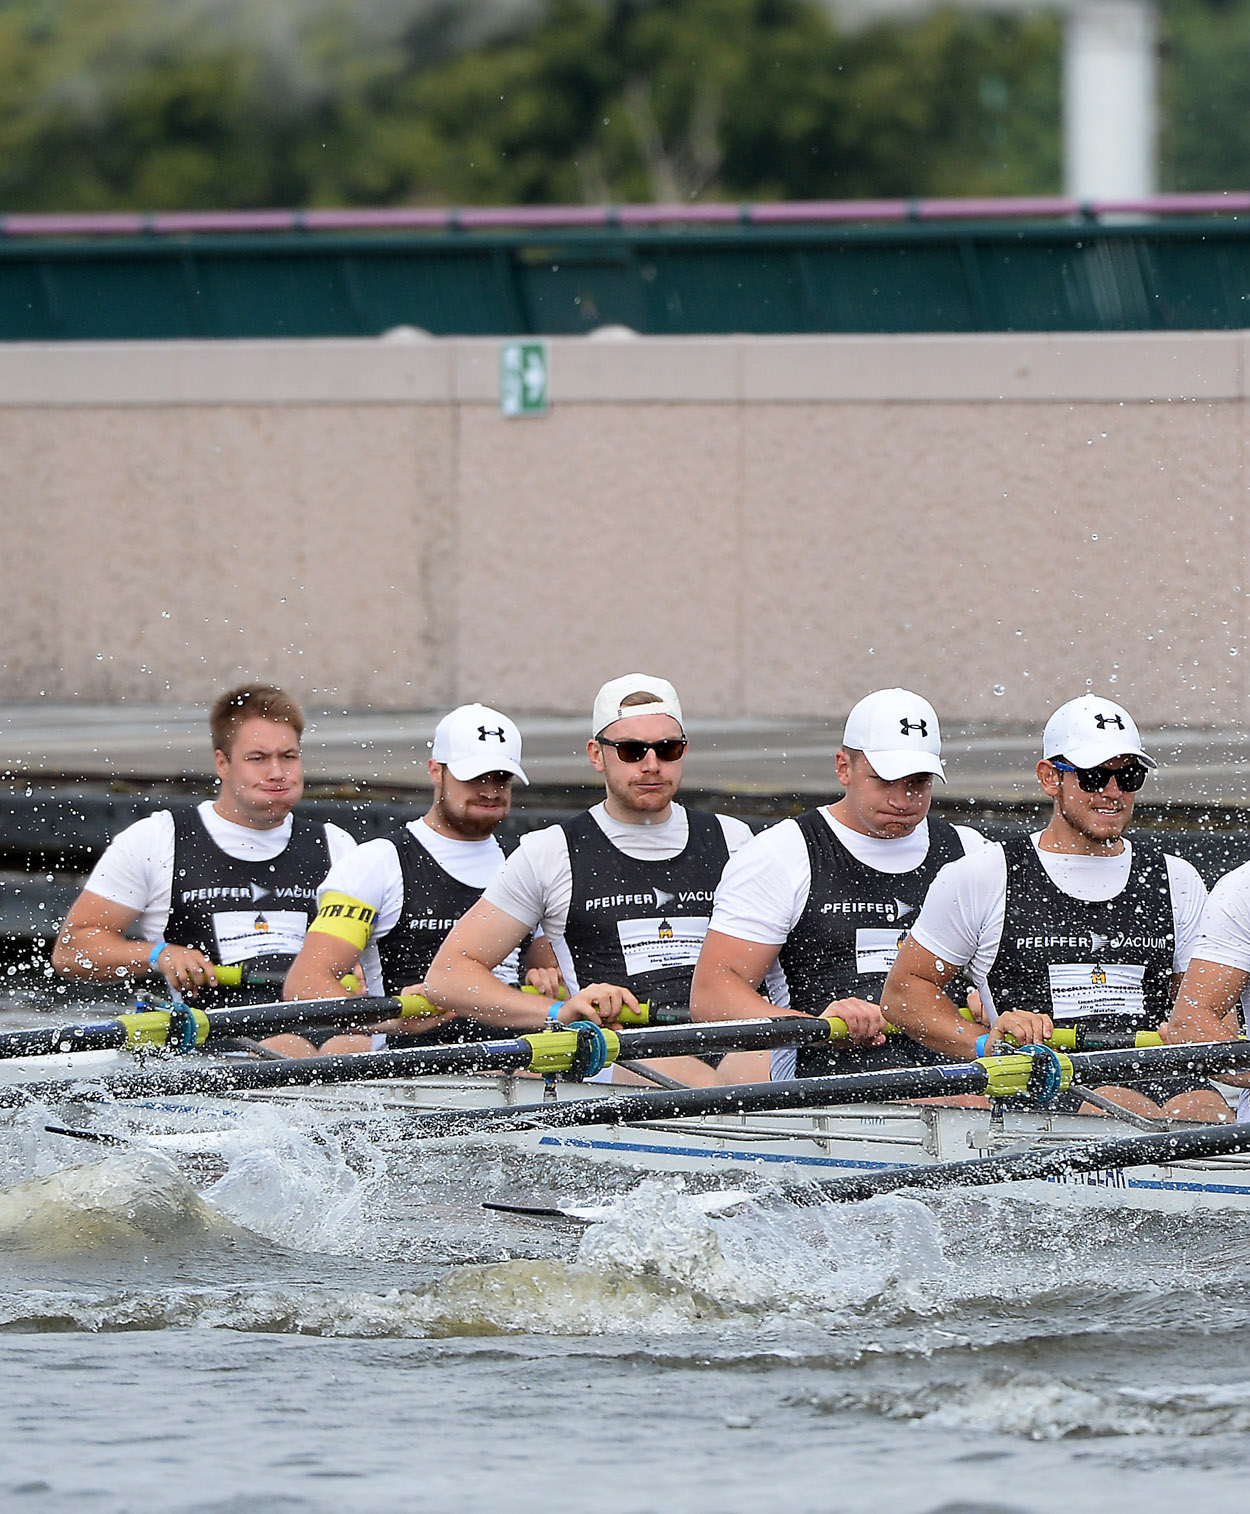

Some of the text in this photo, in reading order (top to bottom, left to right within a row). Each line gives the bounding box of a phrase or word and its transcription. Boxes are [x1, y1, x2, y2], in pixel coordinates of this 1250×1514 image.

[182, 886, 250, 903] PFEIFFER
[585, 893, 654, 911] PFEIFFER
[823, 902, 895, 914] PFEIFFER
[1016, 936, 1166, 950] PFEIFFER VACUUM
